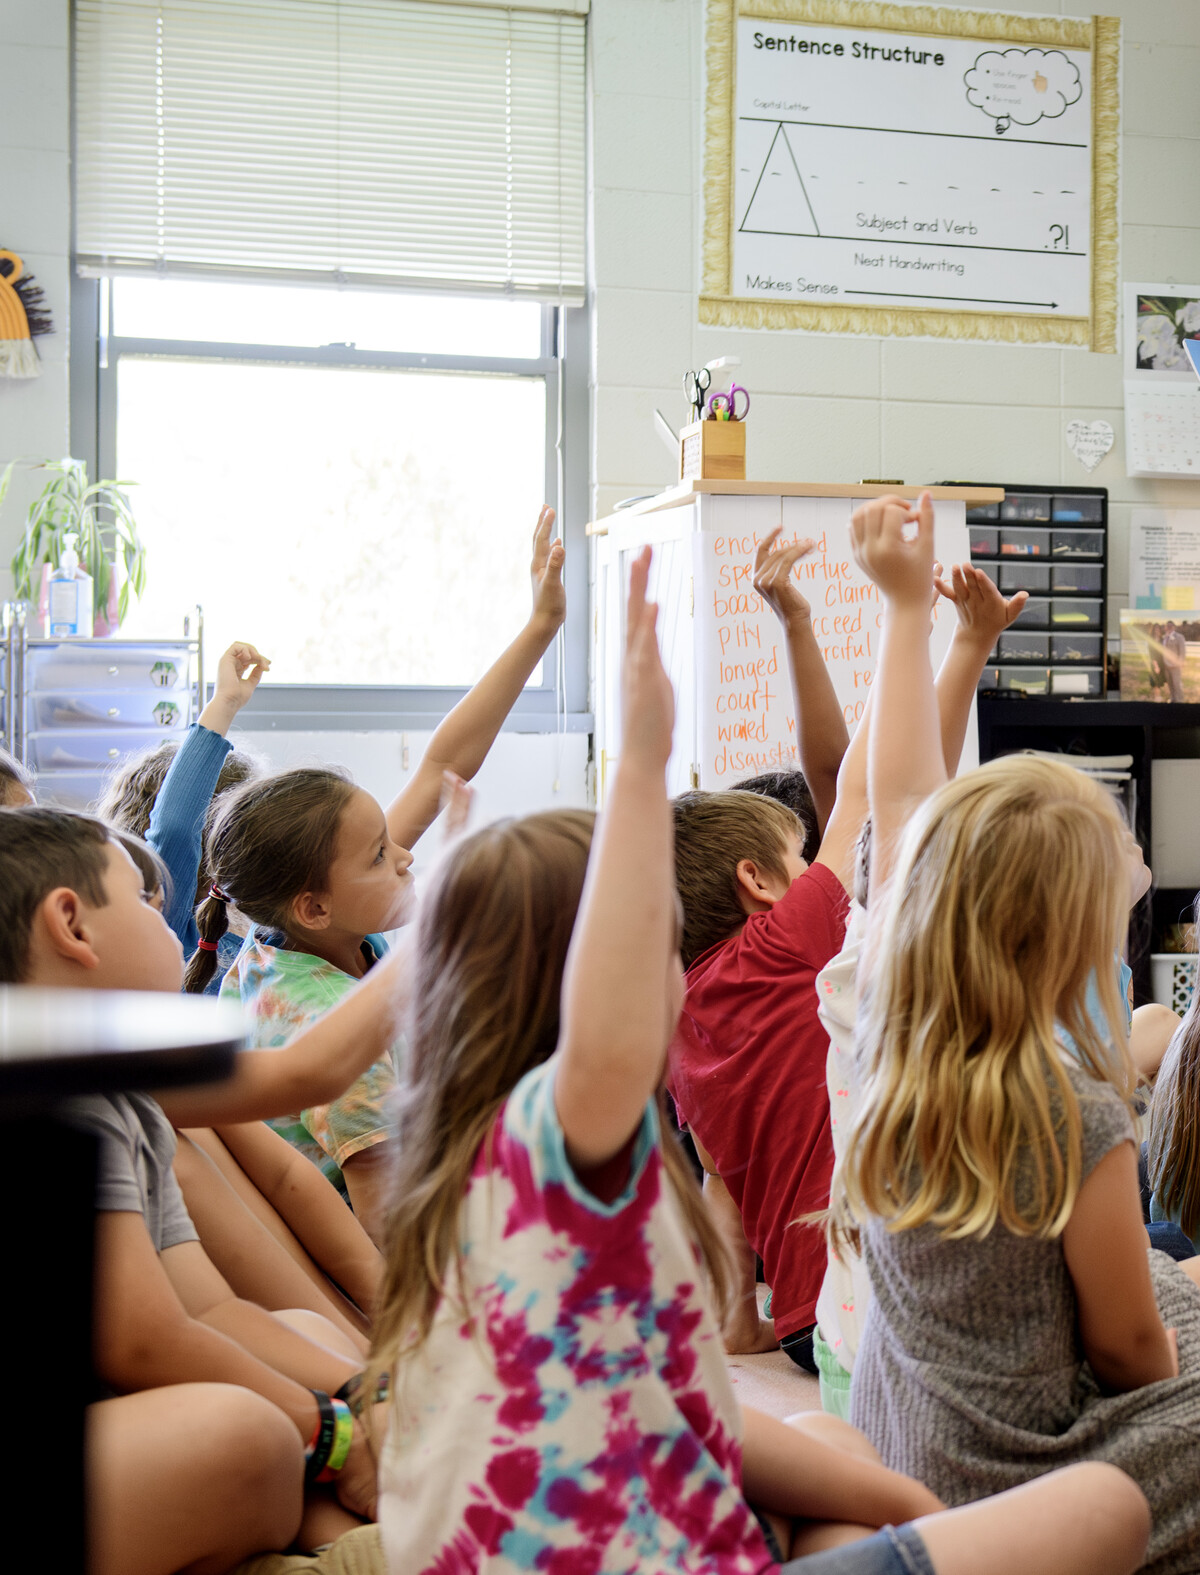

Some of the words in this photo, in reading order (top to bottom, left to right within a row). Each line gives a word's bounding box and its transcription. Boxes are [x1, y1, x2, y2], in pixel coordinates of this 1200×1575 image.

[753, 32, 845, 57] Sentence
[852, 42, 945, 66] Structure
[856, 212, 908, 233] Subject
[912, 215, 939, 233] and
[943, 218, 978, 236] Verb
[854, 252, 885, 268] Neat
[889, 254, 965, 276] Handwriting
[746, 275, 793, 292] Makes
[797, 277, 839, 295] Sense
[793, 554, 853, 580] virtue
[718, 620, 761, 655] pity
[720, 646, 778, 692] longed
[716, 680, 777, 714] court
